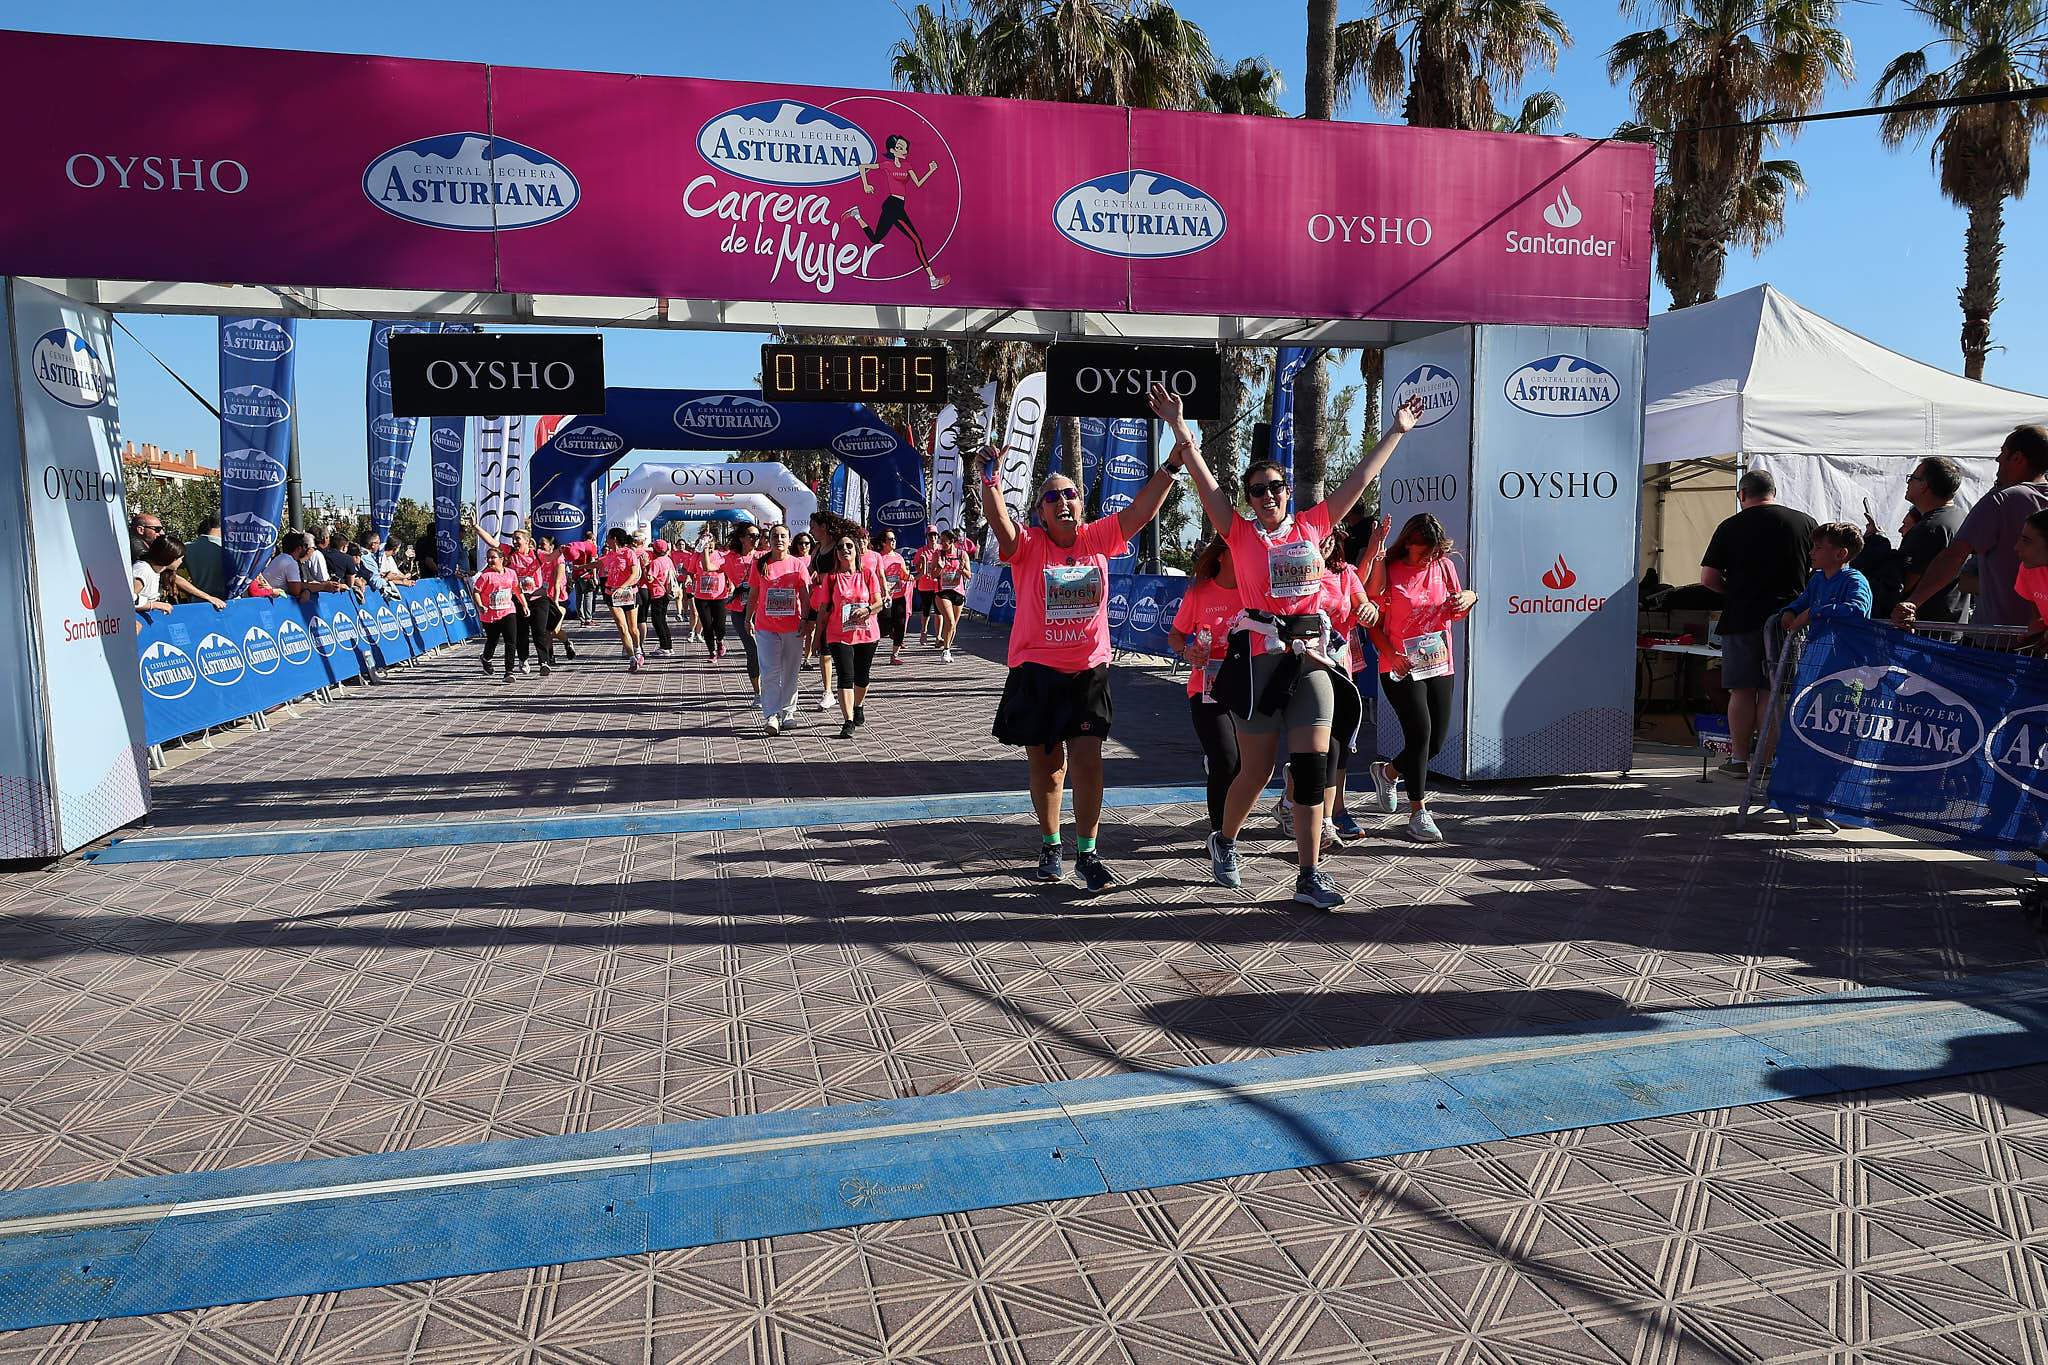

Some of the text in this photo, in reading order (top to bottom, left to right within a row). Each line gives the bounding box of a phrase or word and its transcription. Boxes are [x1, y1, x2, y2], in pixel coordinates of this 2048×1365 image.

[712, 127, 861, 166] ASTURIANA
[738, 127, 857, 142] CENTRAL LECHERA
[65, 153, 249, 193] OYSHO
[414, 165, 482, 176] CENTRAL
[381, 165, 564, 207] ASTURIANA
[682, 174, 831, 226] Carrera
[1067, 200, 1213, 237] ASTURIANA
[1094, 199, 1208, 212] CENTRAL LECHERA
[1307, 213, 1433, 246] OYSHO
[1506, 231, 1617, 257] Santander
[720, 222, 885, 294] de la Mujer
[39, 349, 104, 395] ASTURIANA
[426, 360, 576, 390] OYSHO
[775, 354, 933, 393] 01:10:15
[1076, 366, 1197, 397] OYSHO
[1531, 376, 1608, 385] CENTRAL LECHERA
[1512, 377, 1612, 402] ASTURIANA
[682, 409, 773, 429] ASTURIANA
[558, 437, 618, 451] ASTURIANA
[837, 438, 894, 451] ASTURIANA
[44, 465, 116, 504] OYSHO
[671, 469, 755, 486] OYSHO
[1391, 473, 1457, 505] OYSHO
[1499, 471, 1618, 500] OYSHO
[534, 513, 581, 524] ASTURIANA
[1508, 595, 1607, 615] Santander
[64, 614, 120, 643] Santander
[1045, 629, 1088, 642] SUMA
[145, 665, 194, 689] ASTURIANA
[201, 654, 243, 676] ASTURIANA
[1834, 693, 1964, 724] CETRAL LECHERA
[1800, 692, 1964, 755] ASTURIANA
